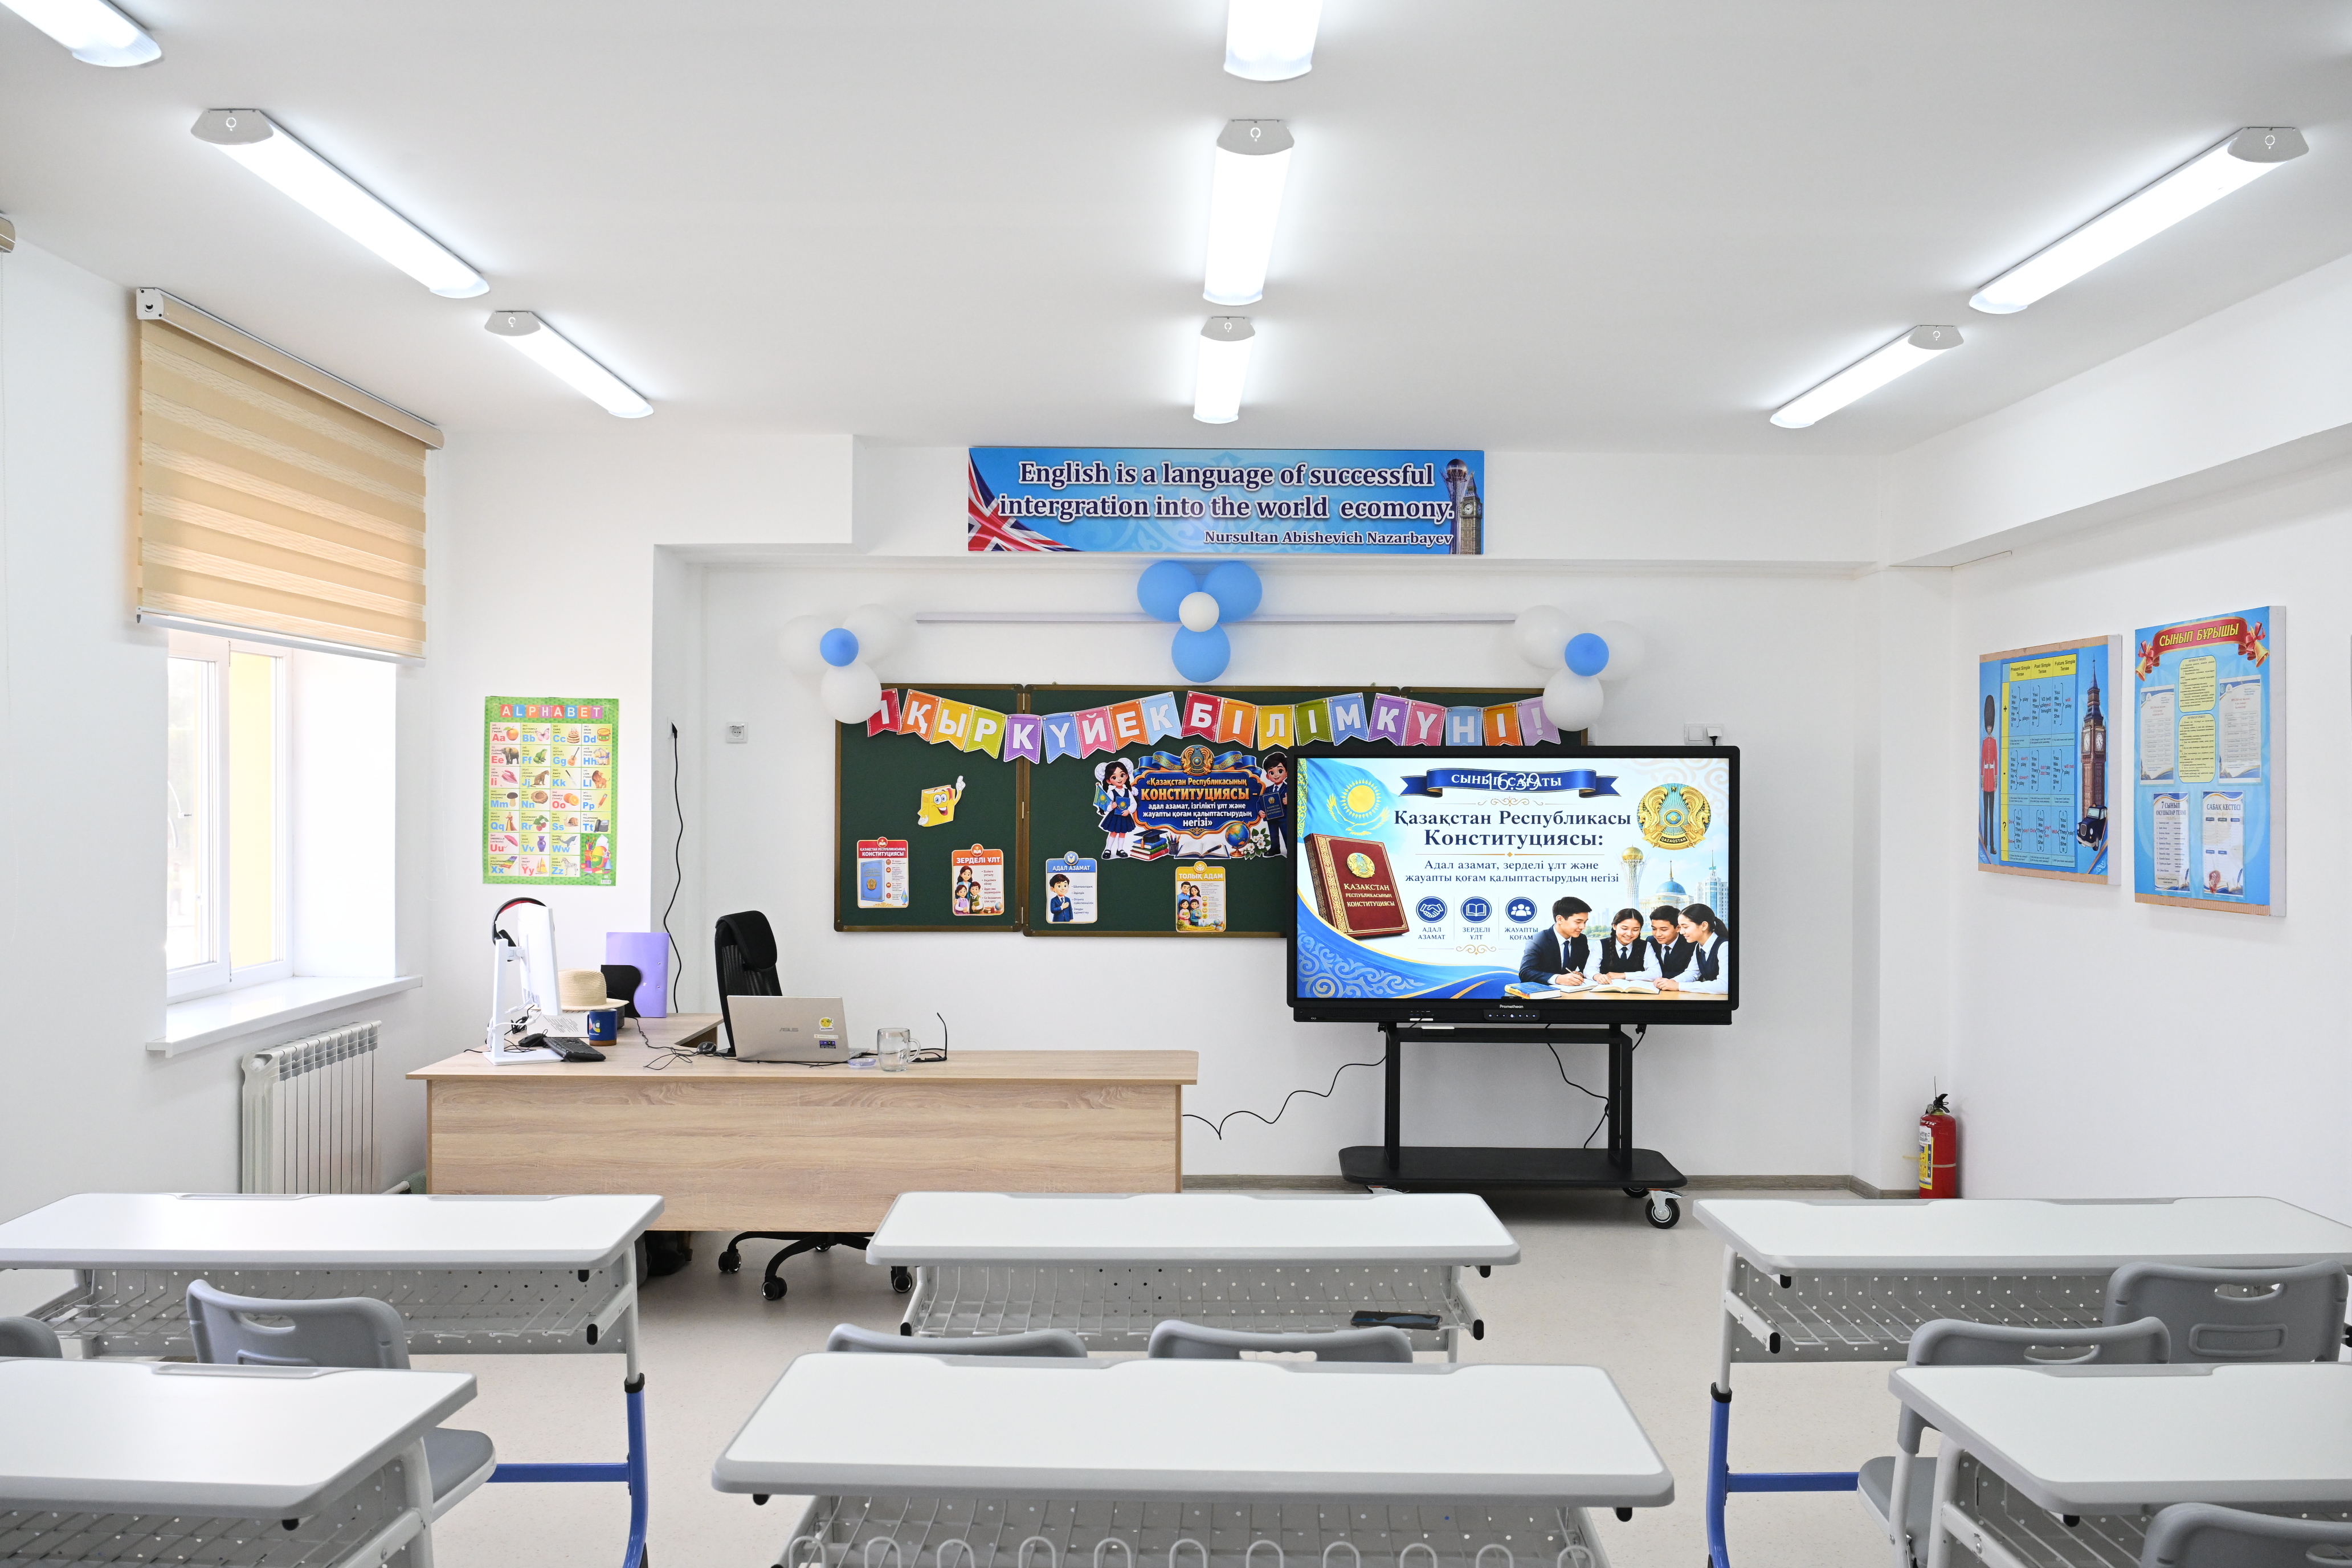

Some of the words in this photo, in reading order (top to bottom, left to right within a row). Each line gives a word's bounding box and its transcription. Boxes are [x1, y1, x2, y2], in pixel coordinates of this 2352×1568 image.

[1020, 463, 1110, 488] English
[1116, 464, 1136, 484] is
[1141, 469, 1156, 484] a
[1162, 464, 1275, 489] language
[1280, 464, 1304, 485] of
[1309, 464, 1433, 486] successful
[999, 495, 1149, 522] intergration
[1155, 495, 1204, 517] into
[1211, 496, 1250, 517] the
[1258, 496, 1328, 517] world
[1341, 501, 1454, 521] ecomony.
[1205, 531, 1280, 543] Nursultan
[1283, 531, 1363, 544] Abishevich
[1367, 532, 1452, 546] Nazarbayev
[2159, 631, 2193, 646] СЫНЫП
[2196, 623, 2239, 640] БҰРЫШЫ
[502, 706, 601, 717] ALPHABET
[906, 701, 1173, 750] ҚЫРКҮЙЕК
[1190, 702, 1361, 737] БІЛІМ
[1377, 705, 1545, 744] КҮНІ!
[553, 757, 566, 766] Gg
[522, 779, 530, 787] Jj
[1189, 778, 1247, 786] Республикасының
[1141, 787, 1249, 801] КОНСТИТУЦИЯСЫ
[1183, 819, 1212, 827] негізі»
[1394, 810, 1491, 827] Қазақстан
[1498, 810, 1631, 827] Республикасы
[491, 822, 504, 831] Qq
[1424, 829, 1603, 849] Конституциясы:
[522, 867, 534, 876] Yy
[1425, 860, 1453, 870] Адал
[1458, 862, 1499, 871] азамат,
[1504, 860, 1544, 872] зерделі
[1548, 862, 1566, 872] ұлт
[1405, 875, 1452, 884] жауапты
[1455, 875, 1485, 884] қоғам
[1490, 875, 1588, 884] қалыптастырудың
